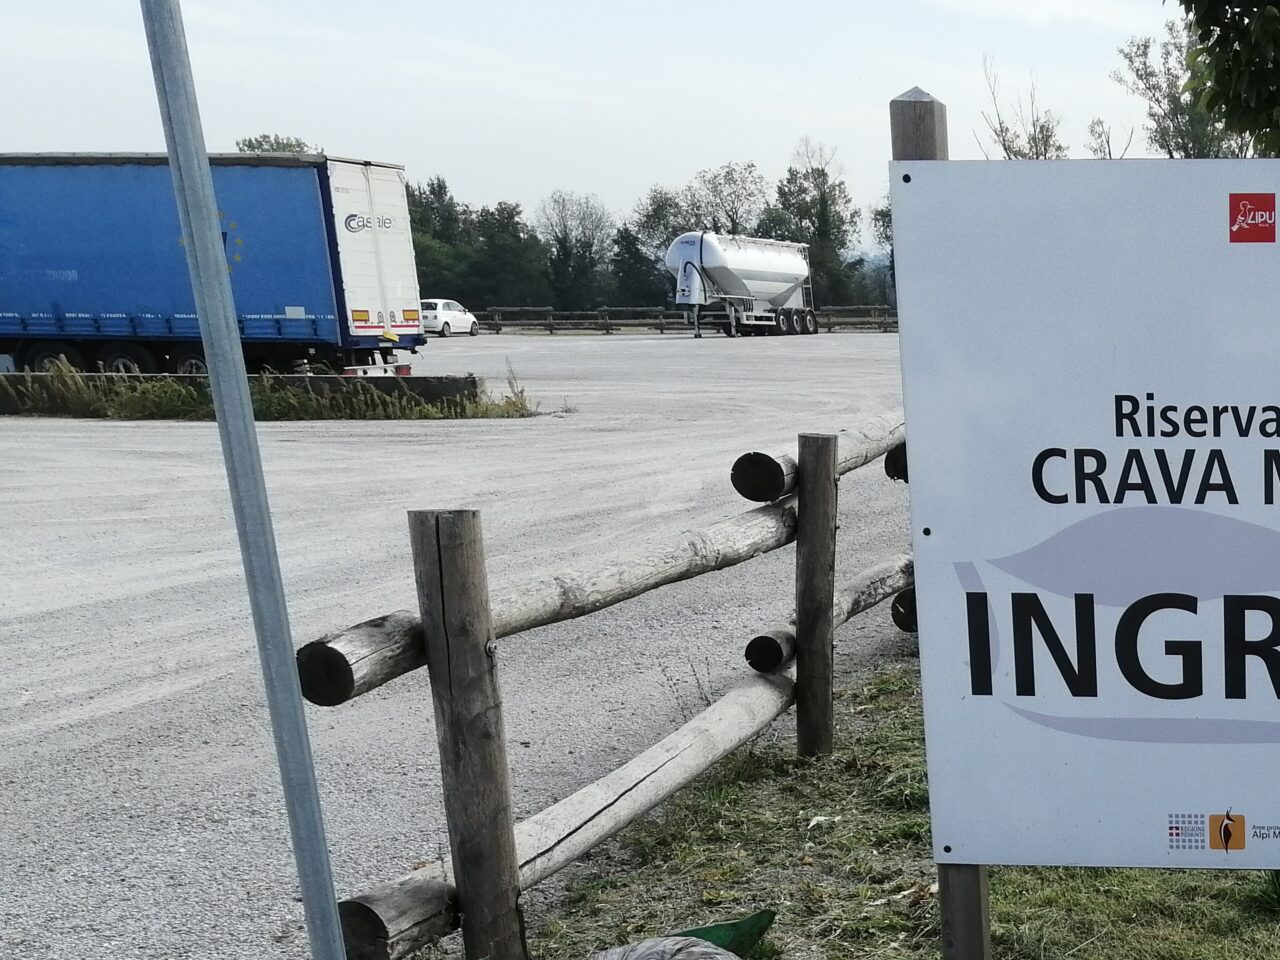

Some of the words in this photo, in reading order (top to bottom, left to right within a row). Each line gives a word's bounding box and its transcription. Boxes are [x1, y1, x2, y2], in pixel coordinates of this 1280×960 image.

[1247, 211, 1275, 224] LIPU
[1031, 448, 1239, 504] CRAVA
[1252, 830, 1271, 840] Alpi
